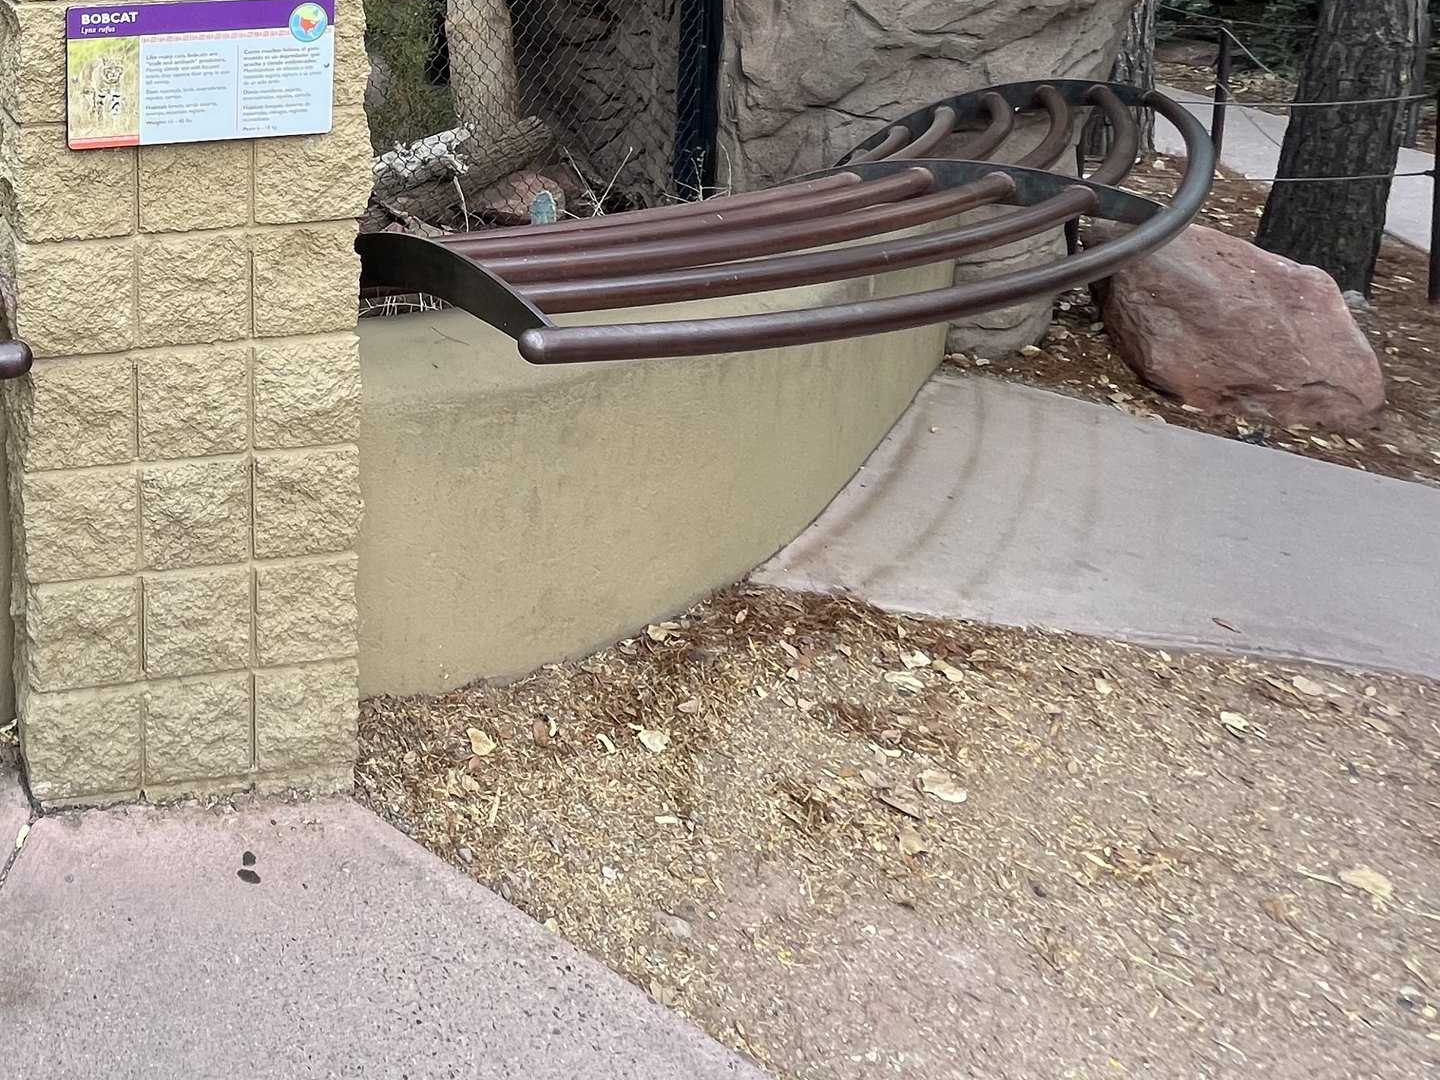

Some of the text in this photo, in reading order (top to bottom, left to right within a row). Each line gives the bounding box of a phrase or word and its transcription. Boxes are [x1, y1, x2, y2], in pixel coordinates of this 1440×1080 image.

[81, 11, 139, 25] BOBCAT
[81, 25, 116, 35] Lynx rufus
